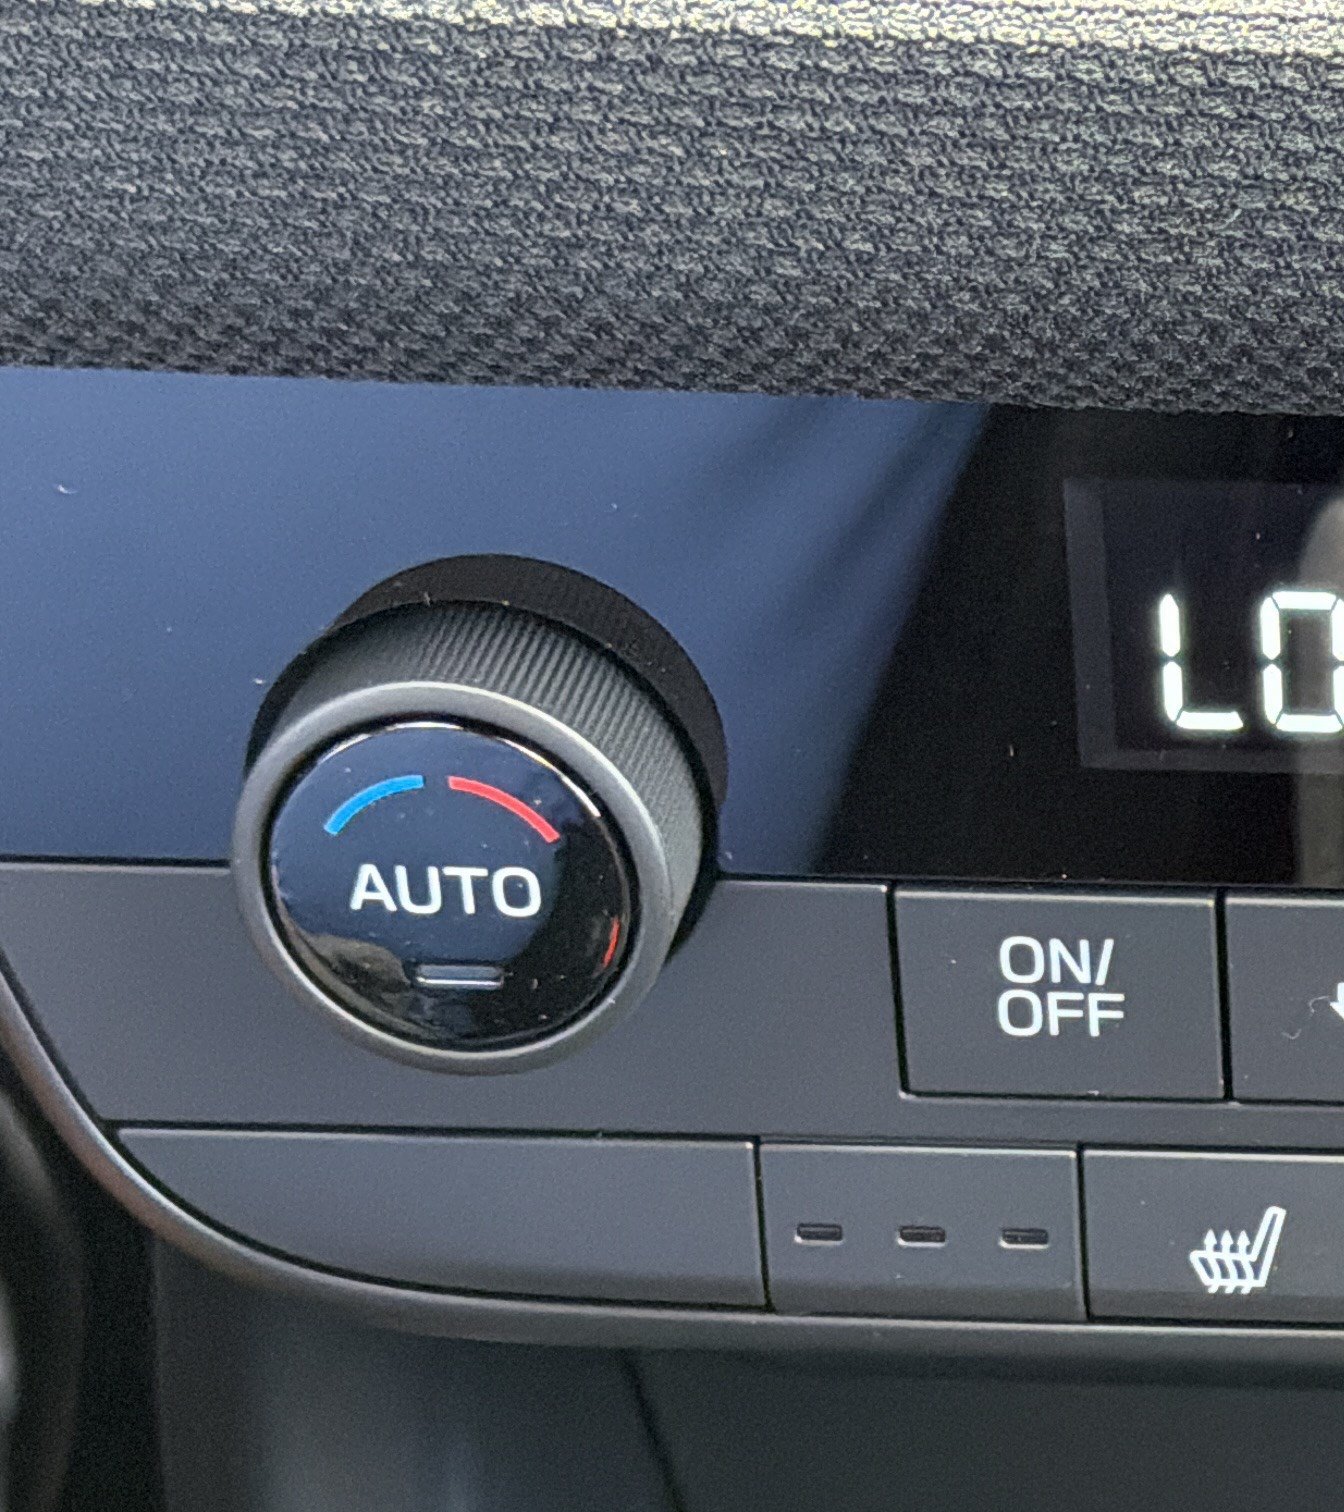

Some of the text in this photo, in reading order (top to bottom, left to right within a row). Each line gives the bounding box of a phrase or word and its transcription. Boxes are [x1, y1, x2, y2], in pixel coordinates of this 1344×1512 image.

[349, 862, 542, 918] AUTO
[998, 935, 1115, 987] ON/
[996, 989, 1126, 1038] OFF
